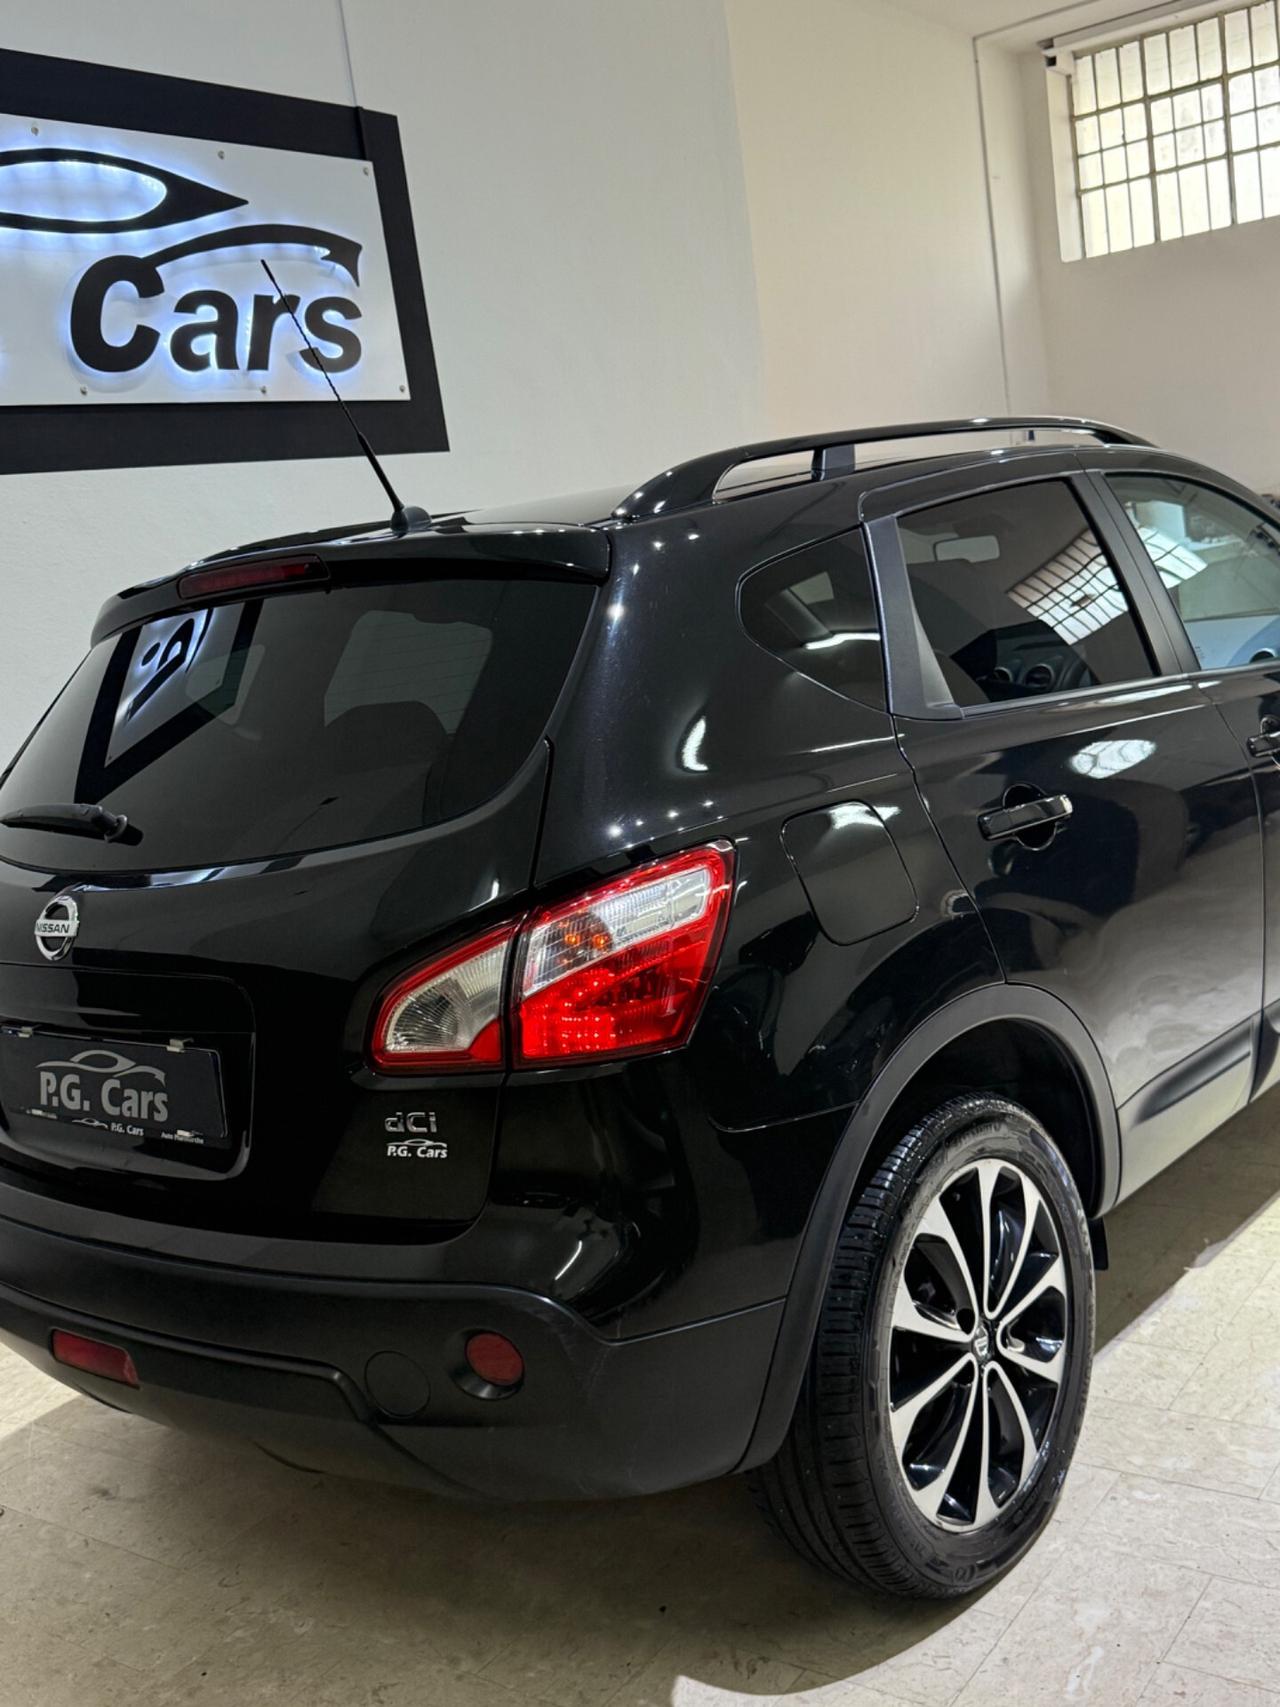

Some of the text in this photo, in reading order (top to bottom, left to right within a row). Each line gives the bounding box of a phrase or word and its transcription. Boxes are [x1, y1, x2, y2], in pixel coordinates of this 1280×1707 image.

[70, 254, 362, 373] Cars
[36, 923, 70, 934] NISSAN
[40, 1071, 169, 1123] P.G. Cars
[110, 1123, 144, 1137] P.G. Cars
[385, 1112, 437, 1133] dCi
[387, 1146, 448, 1159] P.G. Cars
